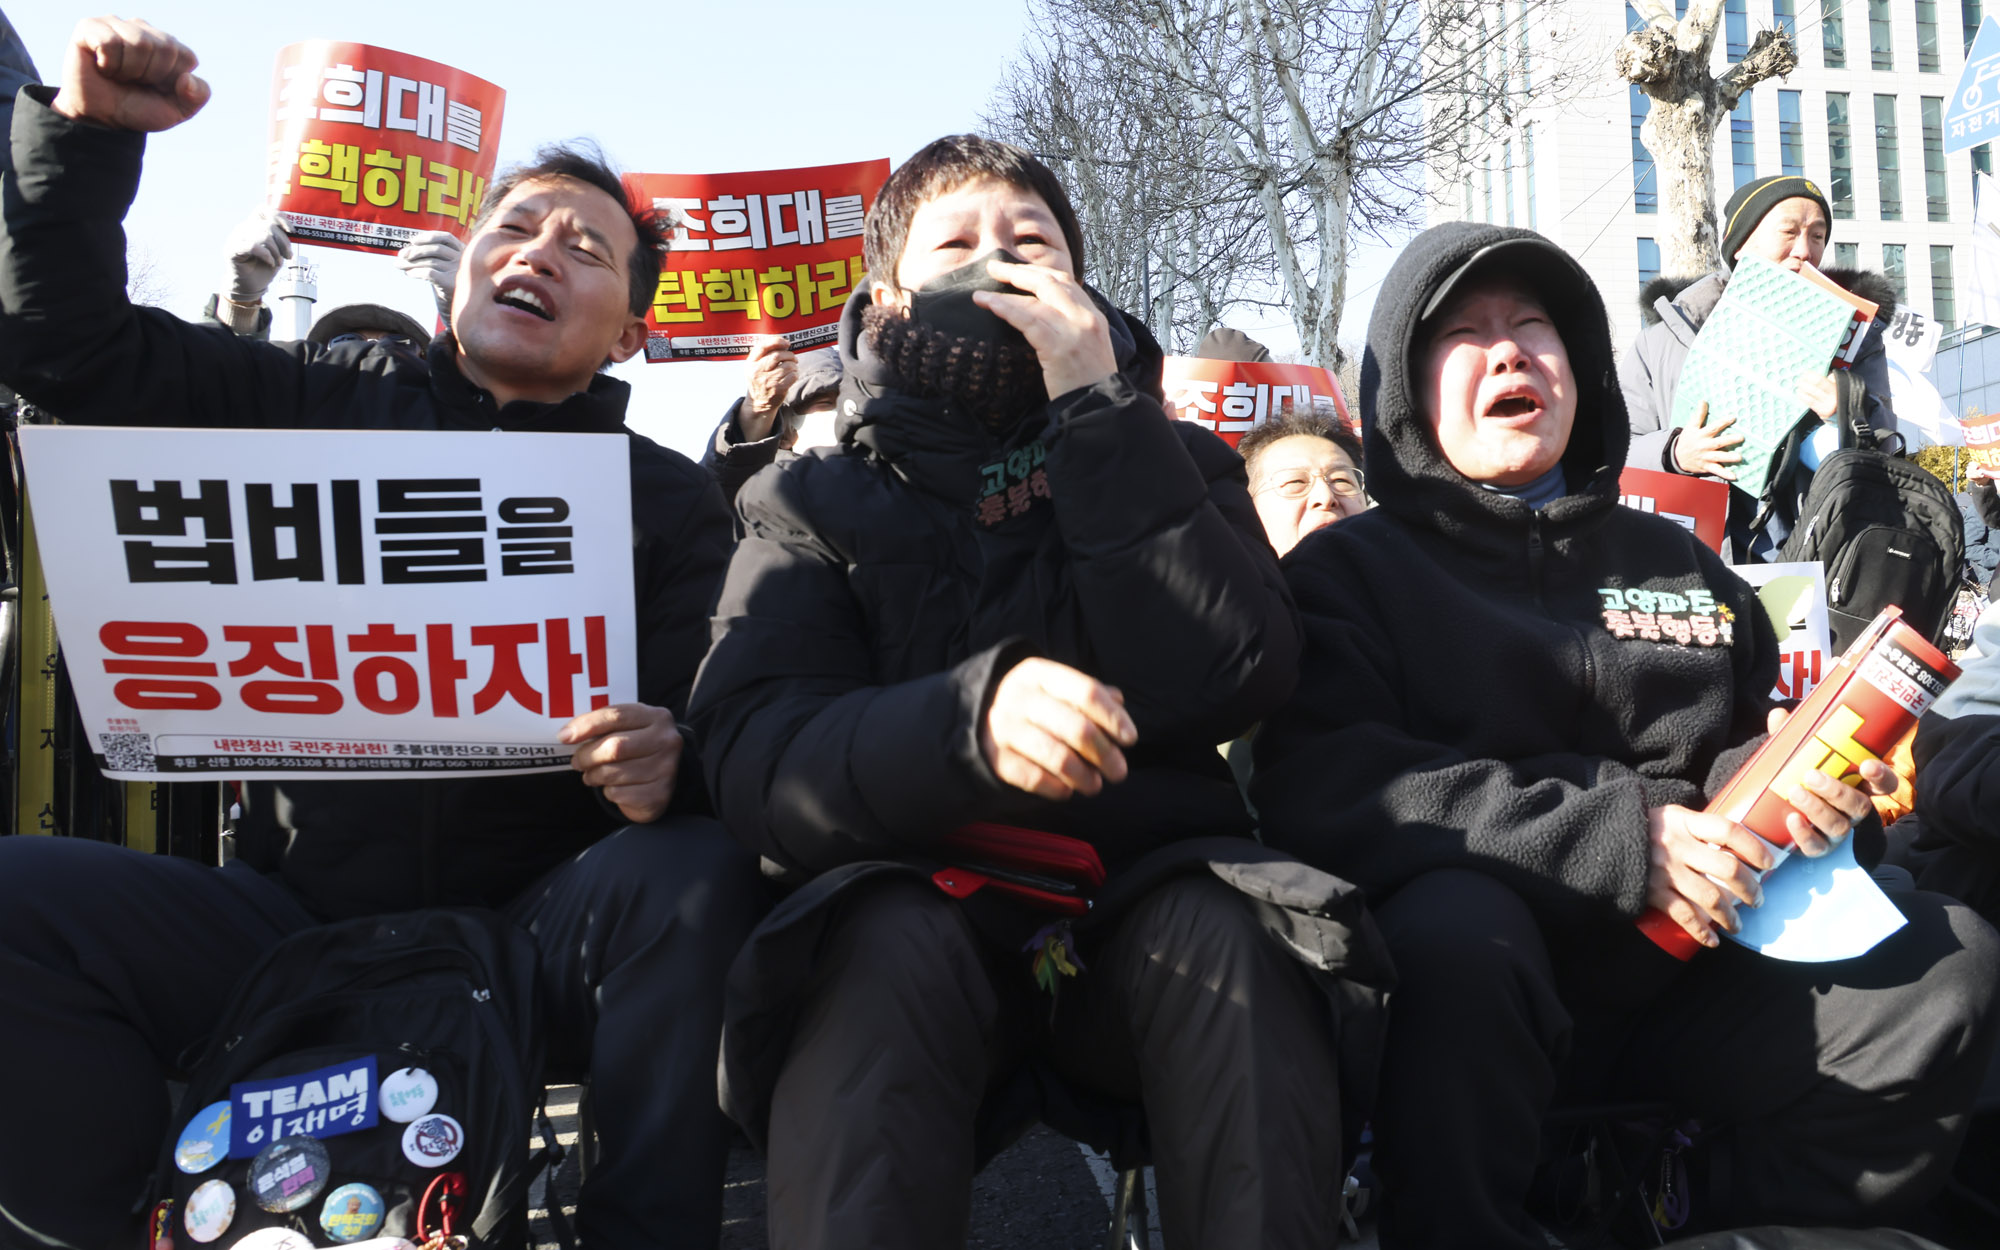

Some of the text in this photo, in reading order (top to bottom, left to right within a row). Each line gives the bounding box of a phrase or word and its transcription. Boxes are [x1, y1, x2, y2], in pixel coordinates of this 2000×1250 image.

[1951, 107, 2000, 138] 자전거
[319, 218, 373, 234] 국민주권실현!
[652, 189, 864, 251] 조희대를
[389, 240, 403, 248] ARS
[697, 336, 731, 346] 내란청산!
[108, 478, 575, 585] 법비들을
[1602, 609, 1720, 646] 촛불행동
[98, 615, 610, 718] 응징하자!
[174, 757, 197, 768] 후원
[208, 757, 231, 768] 신한
[233, 757, 322, 768] 100-036-551308
[324, 758, 412, 768] 촛불승리전환행동
[414, 758, 419, 768] /
[422, 760, 445, 768] ARS
[213, 738, 556, 756] 내란청산! 국민주권실현! 촛불대행진으로 모이자!
[242, 1067, 368, 1119] TEAM
[246, 1092, 368, 1143] 이재명
